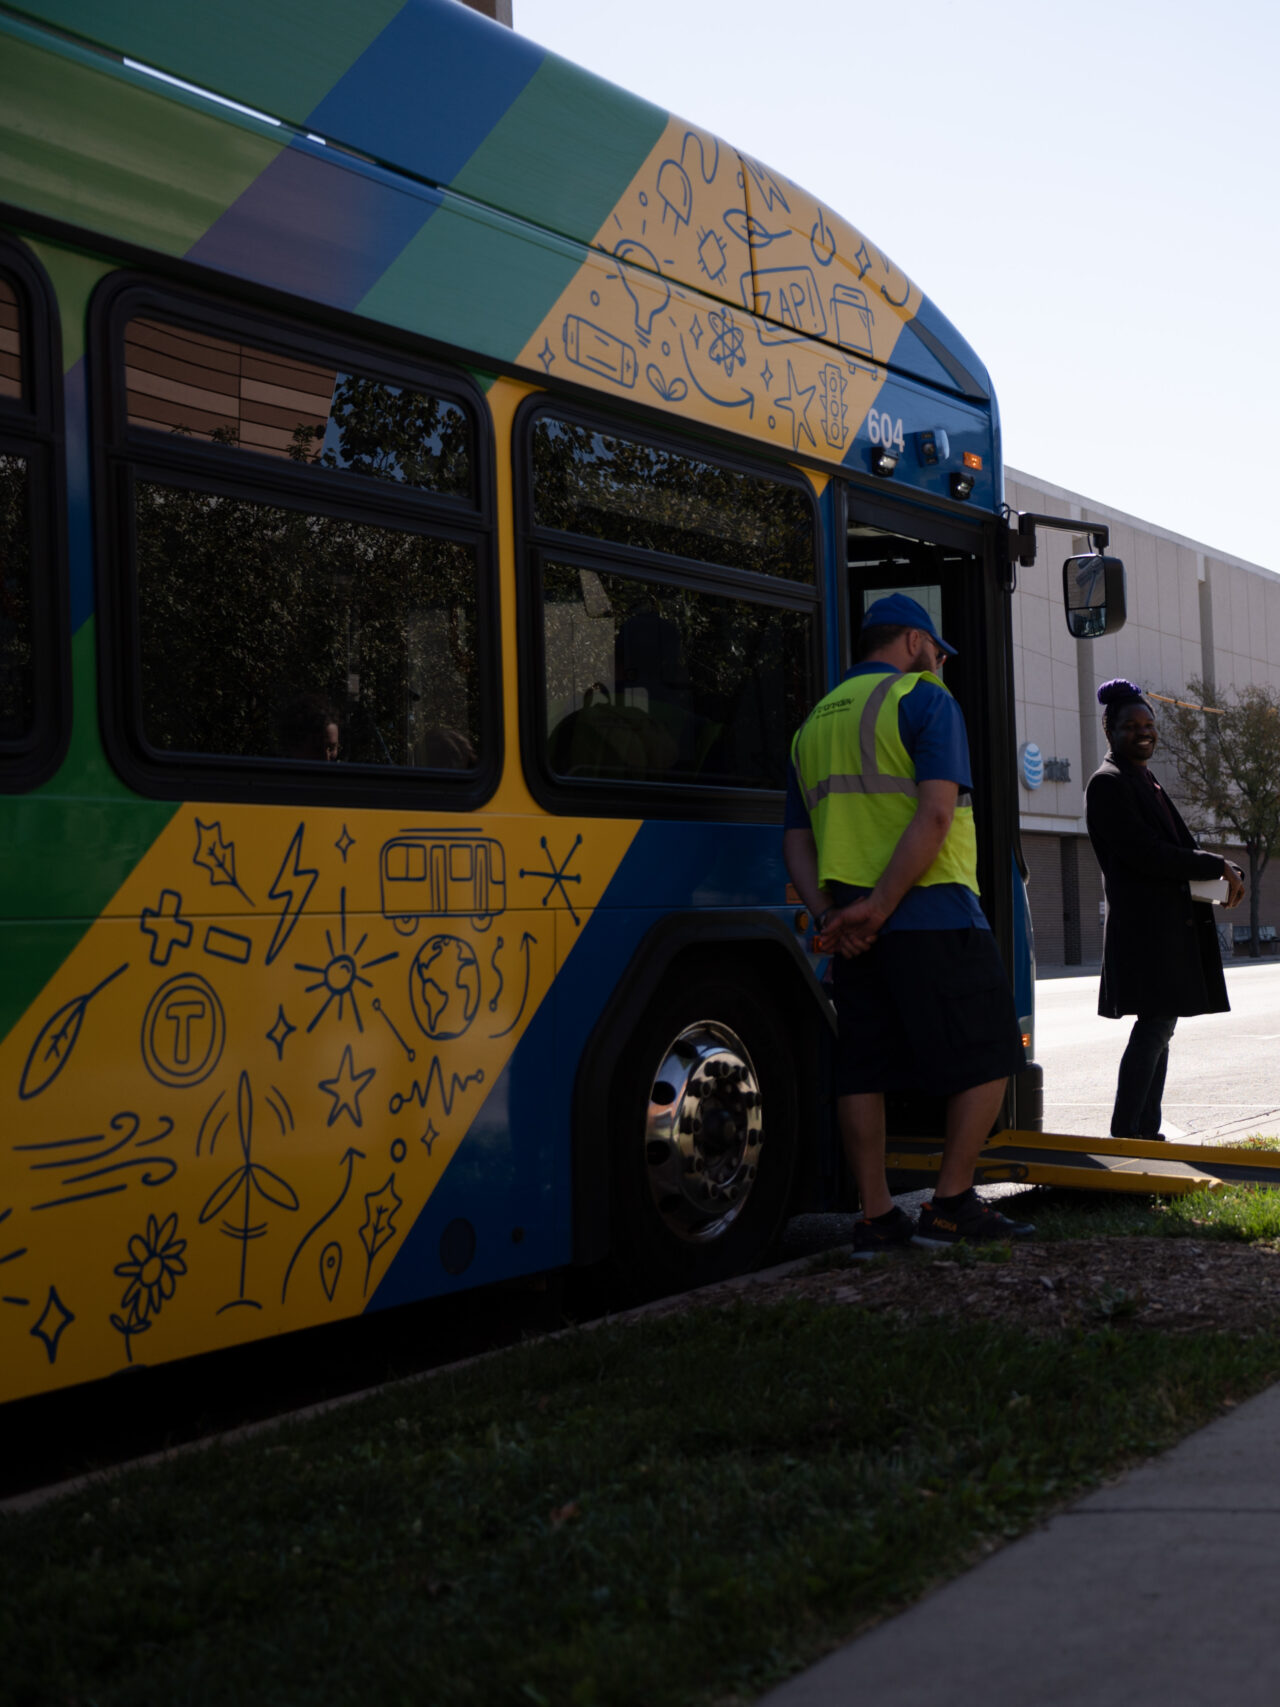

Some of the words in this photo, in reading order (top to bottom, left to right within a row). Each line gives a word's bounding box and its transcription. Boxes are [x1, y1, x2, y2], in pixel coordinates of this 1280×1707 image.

[752, 276, 818, 332] ZAP!
[868, 408, 905, 453] 604
[166, 1001, 206, 1065] T
